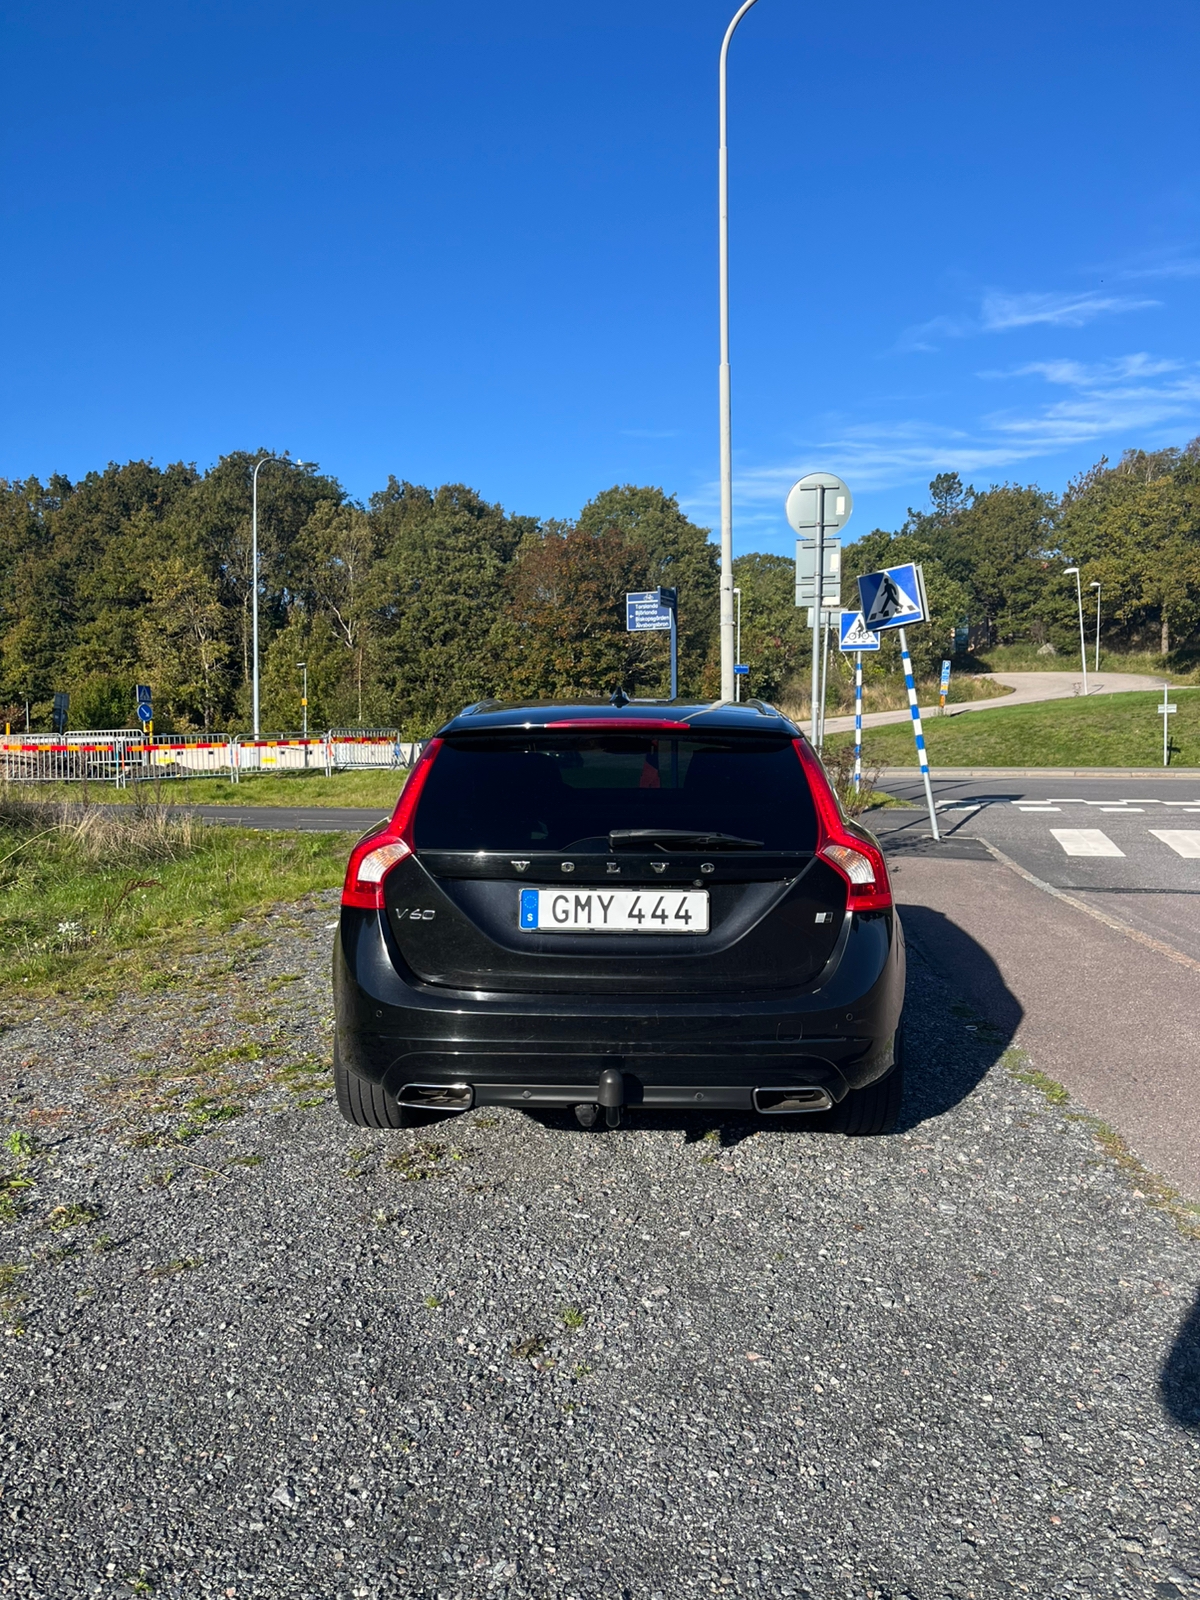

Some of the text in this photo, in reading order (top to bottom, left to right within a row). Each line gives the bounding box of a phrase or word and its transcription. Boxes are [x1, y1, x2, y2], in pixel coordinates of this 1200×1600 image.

[511, 861, 715, 873] VOLVO
[395, 908, 435, 919] V60
[552, 895, 692, 924] GMY 444
[526, 913, 534, 922] S
